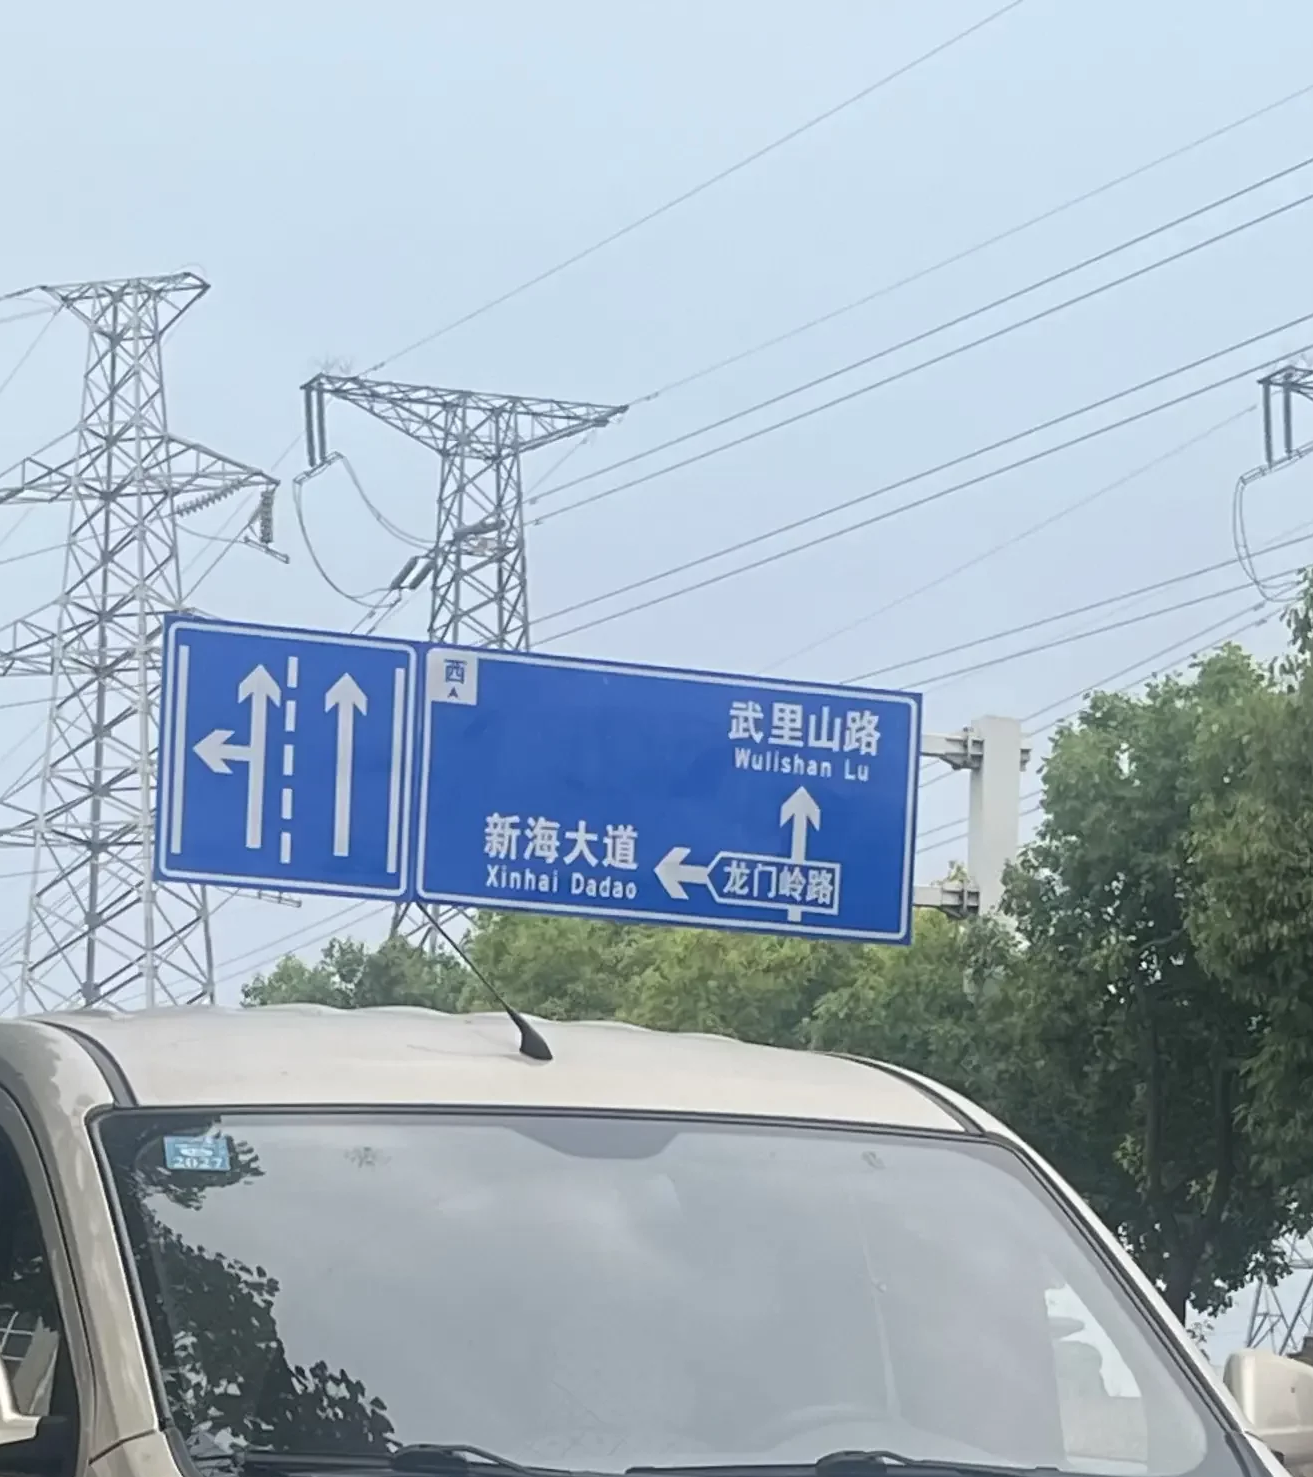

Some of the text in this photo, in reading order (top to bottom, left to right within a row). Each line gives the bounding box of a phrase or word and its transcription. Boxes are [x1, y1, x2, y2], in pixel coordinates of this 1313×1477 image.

[444, 659, 467, 684] 西
[728, 701, 881, 756] 武里山路
[734, 747, 869, 782] Wulishan Lu
[484, 812, 638, 870] 新海大道
[486, 864, 637, 899] Xinhai Dadao
[723, 860, 834, 905] 龙门岭路
